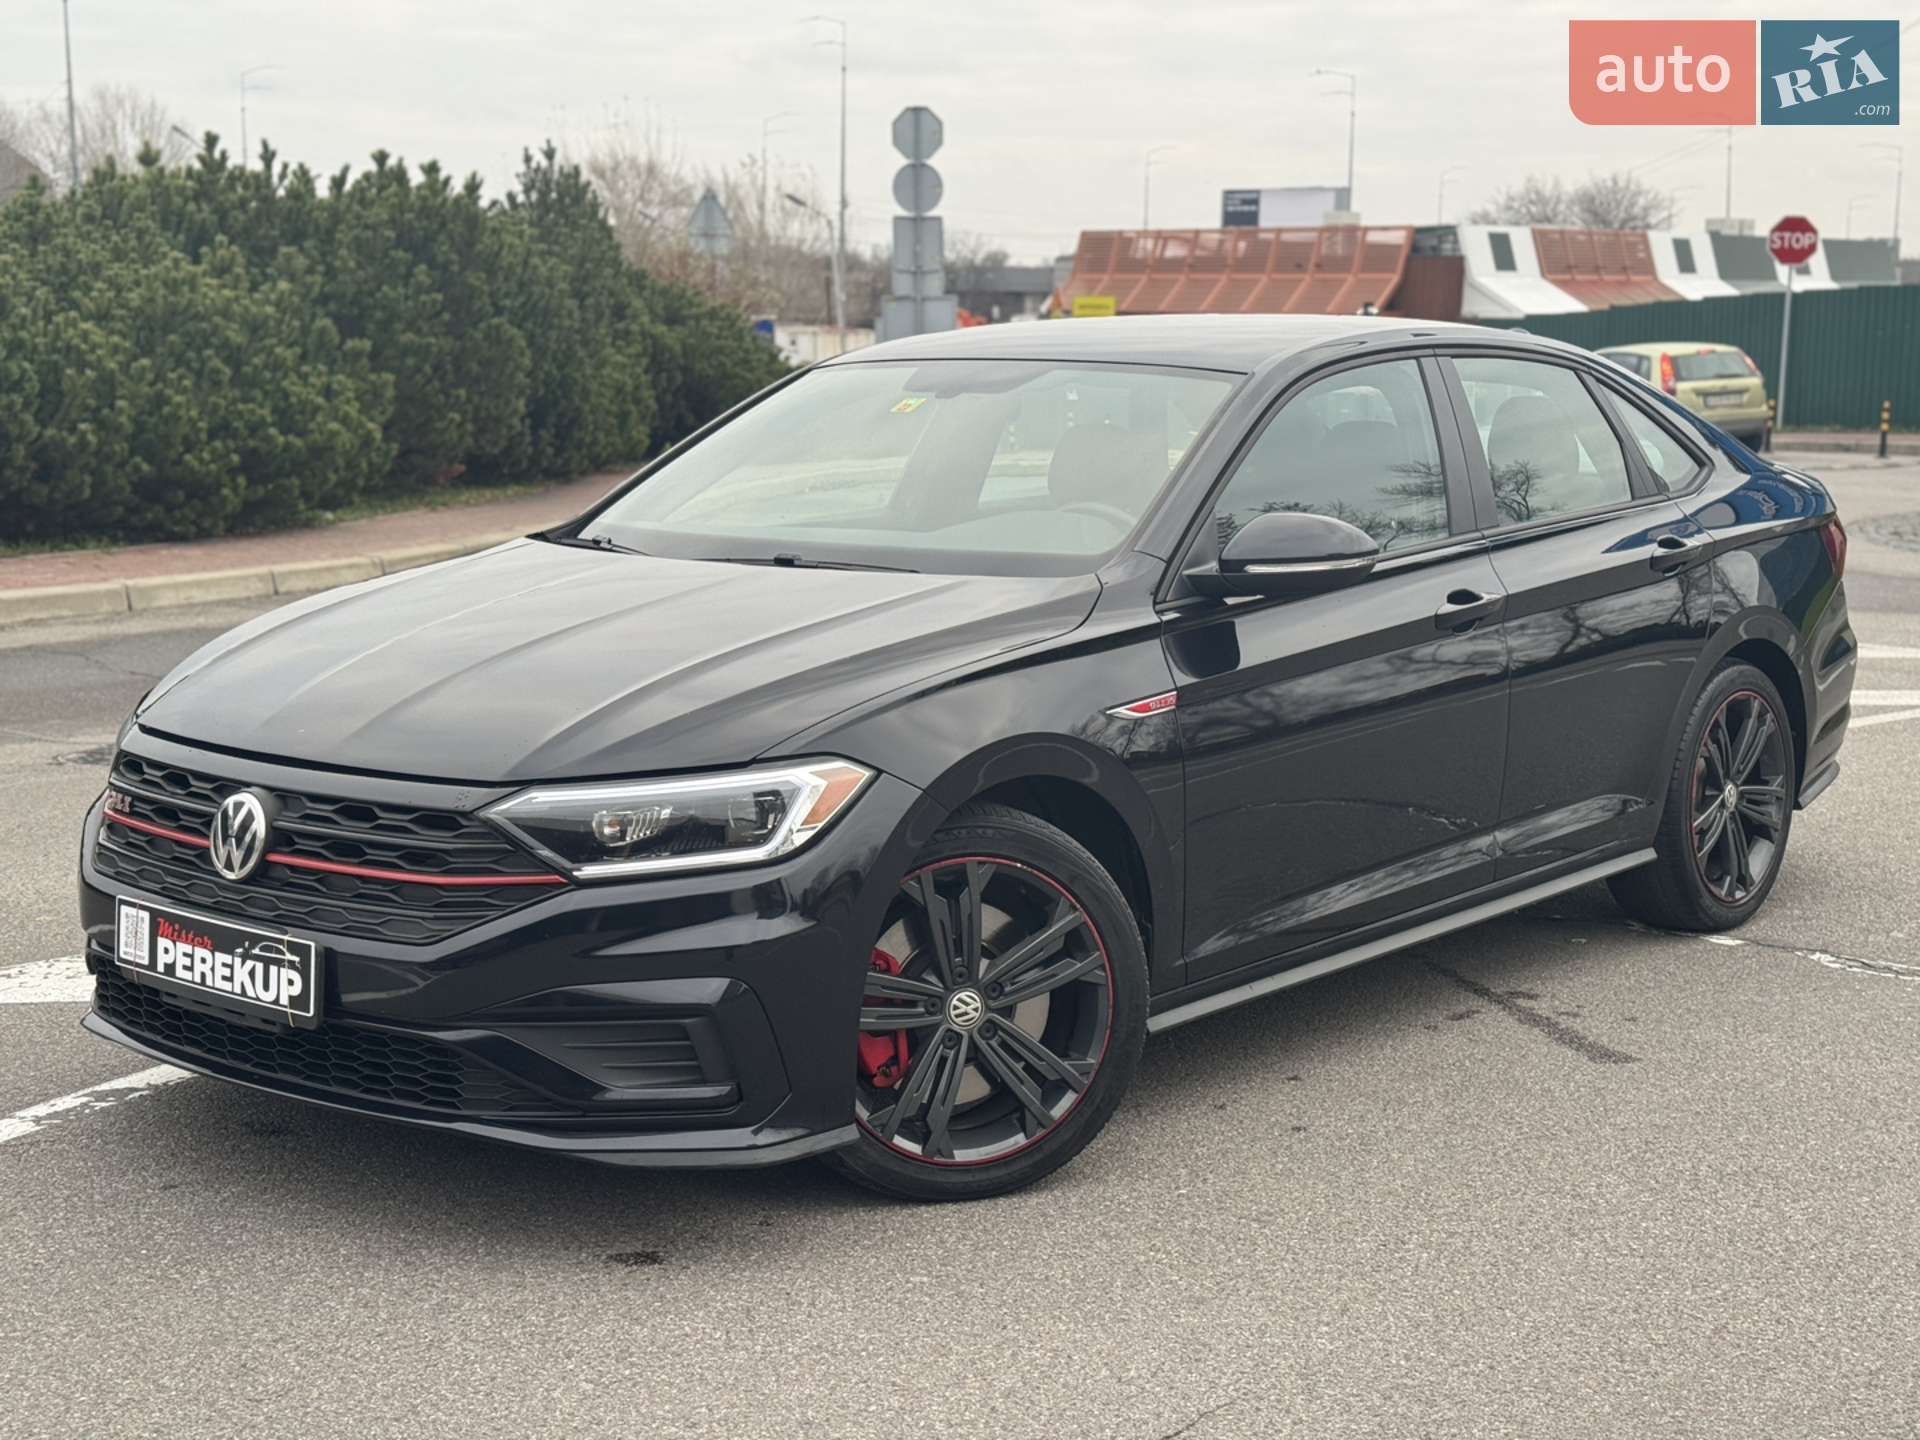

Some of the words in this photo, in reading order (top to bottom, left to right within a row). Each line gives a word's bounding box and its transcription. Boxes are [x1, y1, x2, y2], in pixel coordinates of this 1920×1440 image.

[1770, 231, 1816, 250] STOP
[157, 917, 213, 950] Mister
[157, 936, 302, 1006] PEREKUP
